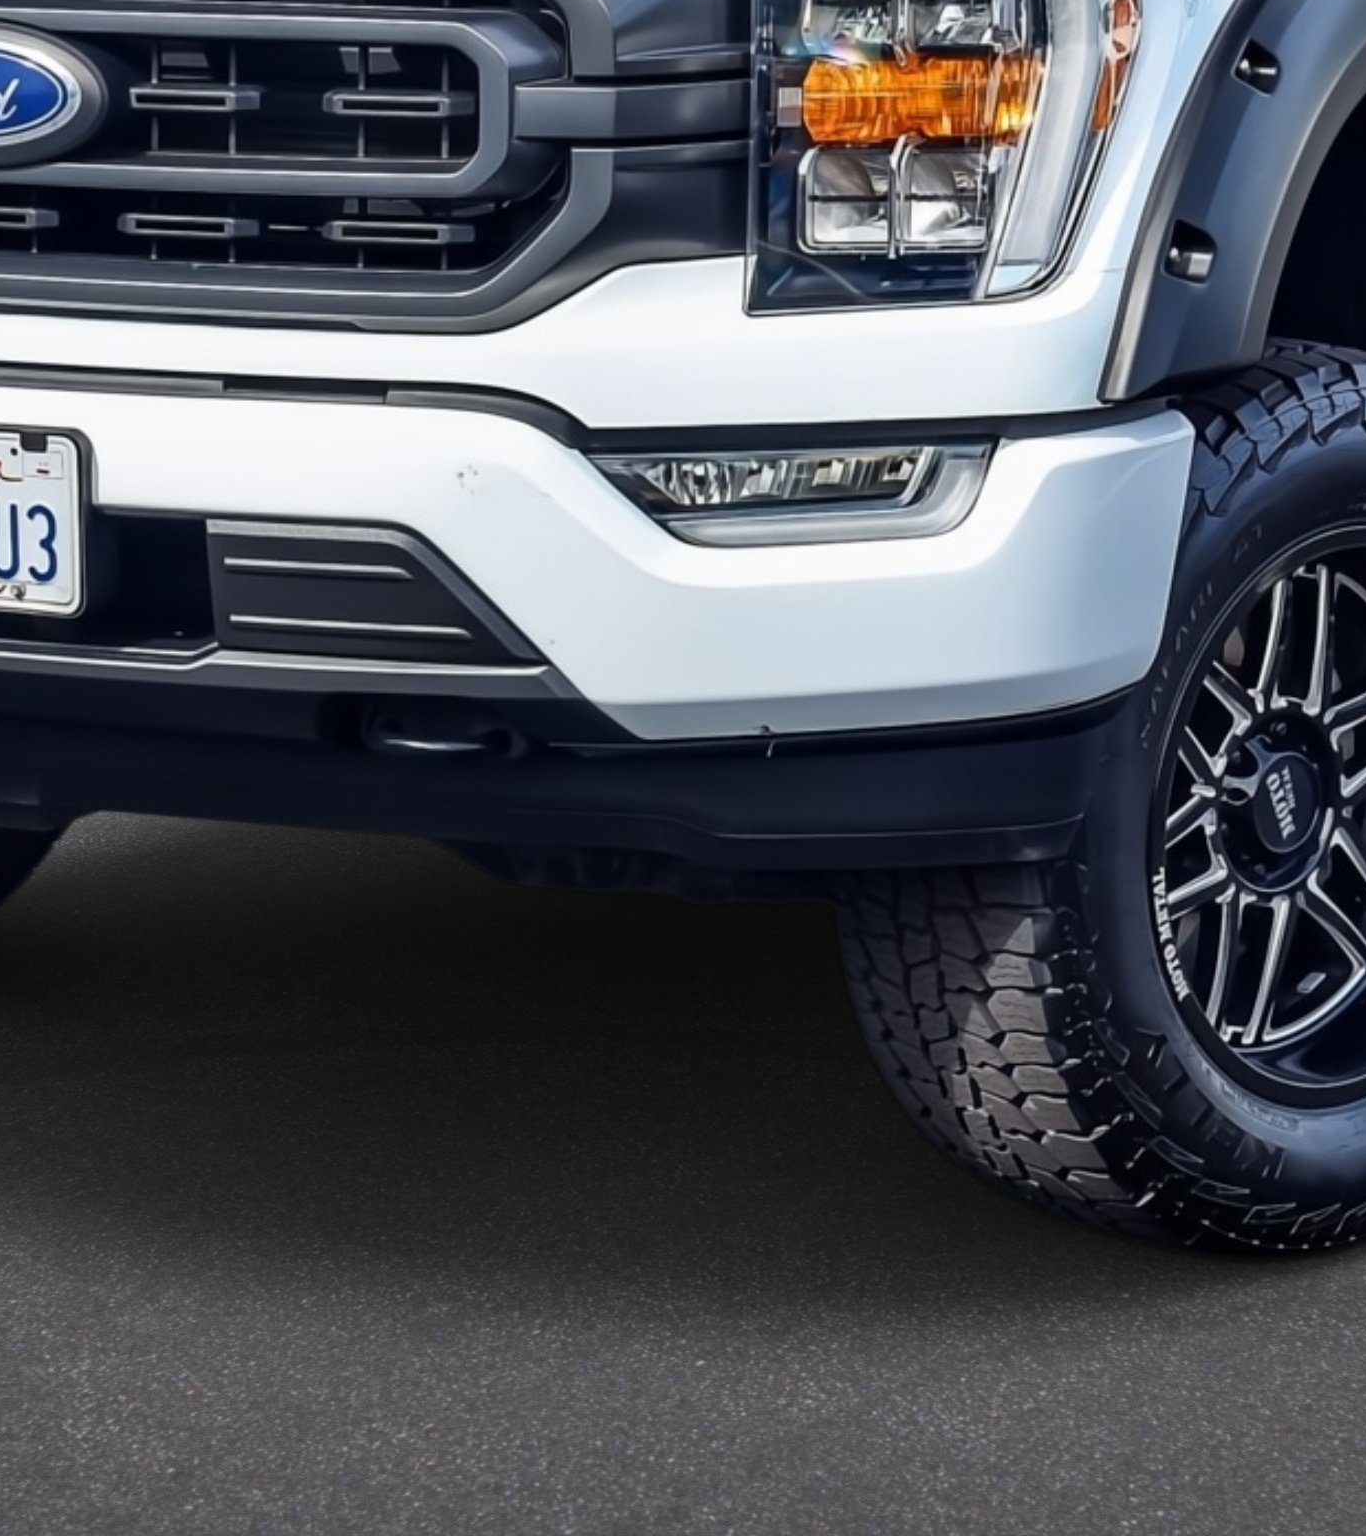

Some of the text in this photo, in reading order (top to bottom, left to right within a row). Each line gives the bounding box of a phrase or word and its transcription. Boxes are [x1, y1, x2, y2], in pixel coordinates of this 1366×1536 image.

[1266, 772, 1295, 840] MOTO
[1152, 866, 1190, 1002] MOTO METAL
